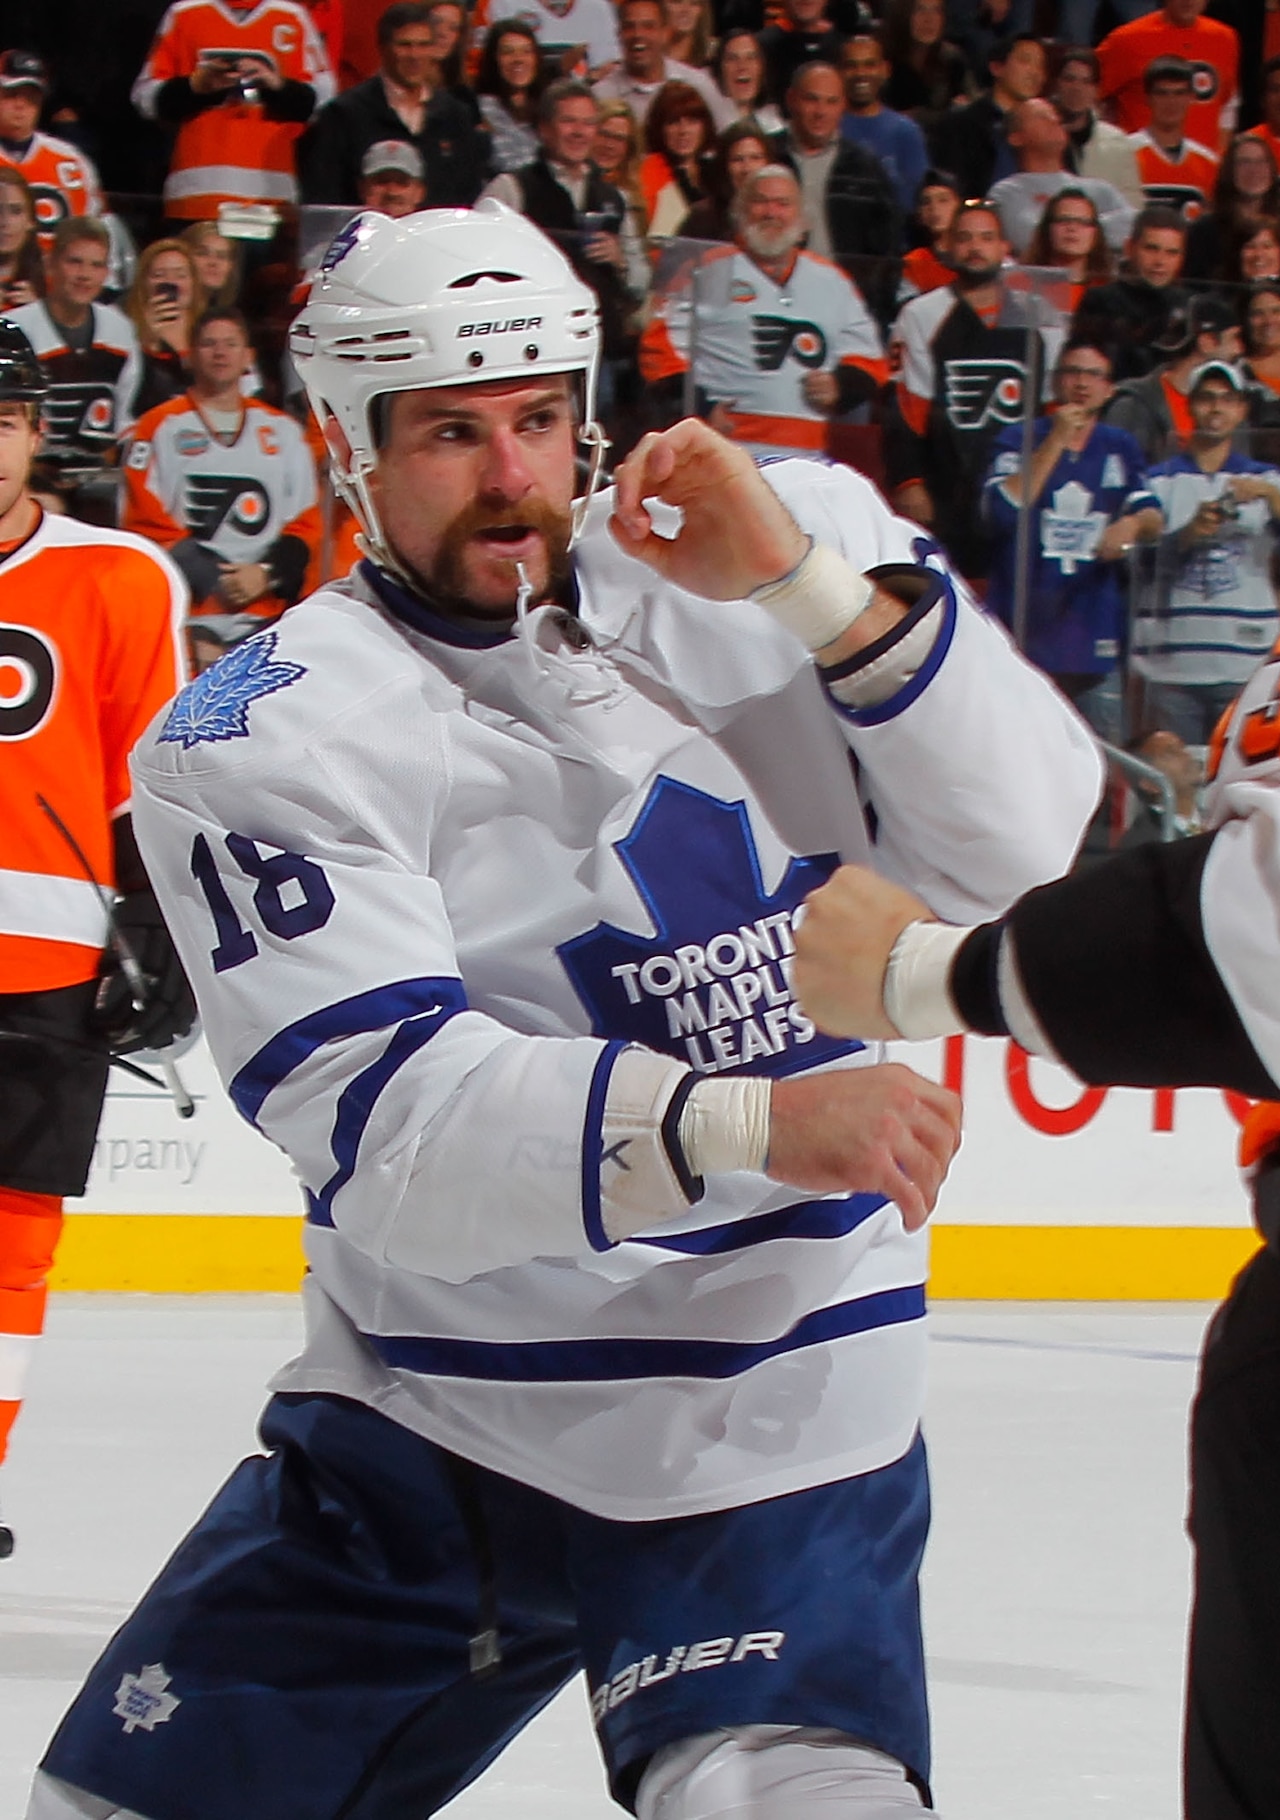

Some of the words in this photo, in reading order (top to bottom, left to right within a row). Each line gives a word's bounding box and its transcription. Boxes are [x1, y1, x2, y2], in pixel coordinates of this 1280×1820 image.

[272, 24, 296, 53] C
[56, 161, 83, 190] C
[456, 316, 543, 339] BAUER
[256, 425, 281, 456] C
[190, 831, 336, 975] 18
[685, 1001, 816, 1075] LEAFS
